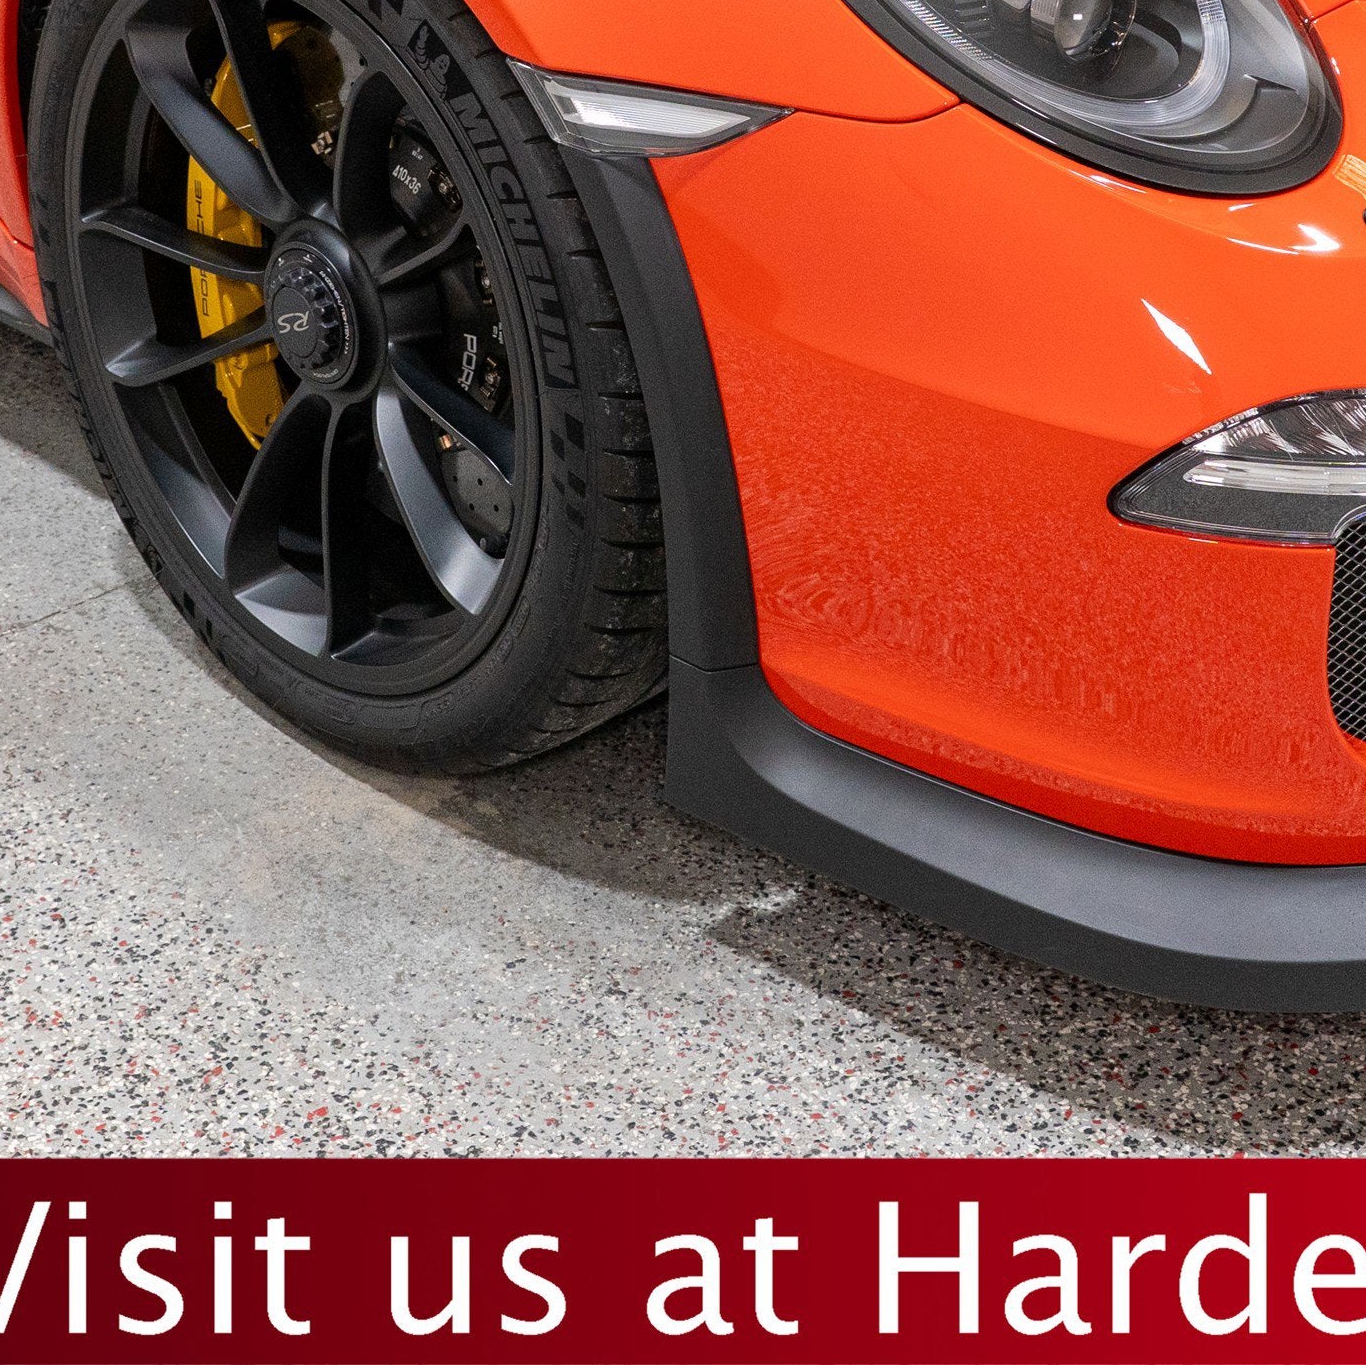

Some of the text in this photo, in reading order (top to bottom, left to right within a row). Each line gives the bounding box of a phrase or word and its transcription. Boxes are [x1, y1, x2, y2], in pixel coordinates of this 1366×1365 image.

[392, 164, 422, 194] 410x36
[194, 179, 209, 317] POCHE
[448, 91, 576, 386] MICHELIN
[277, 310, 310, 334] RS
